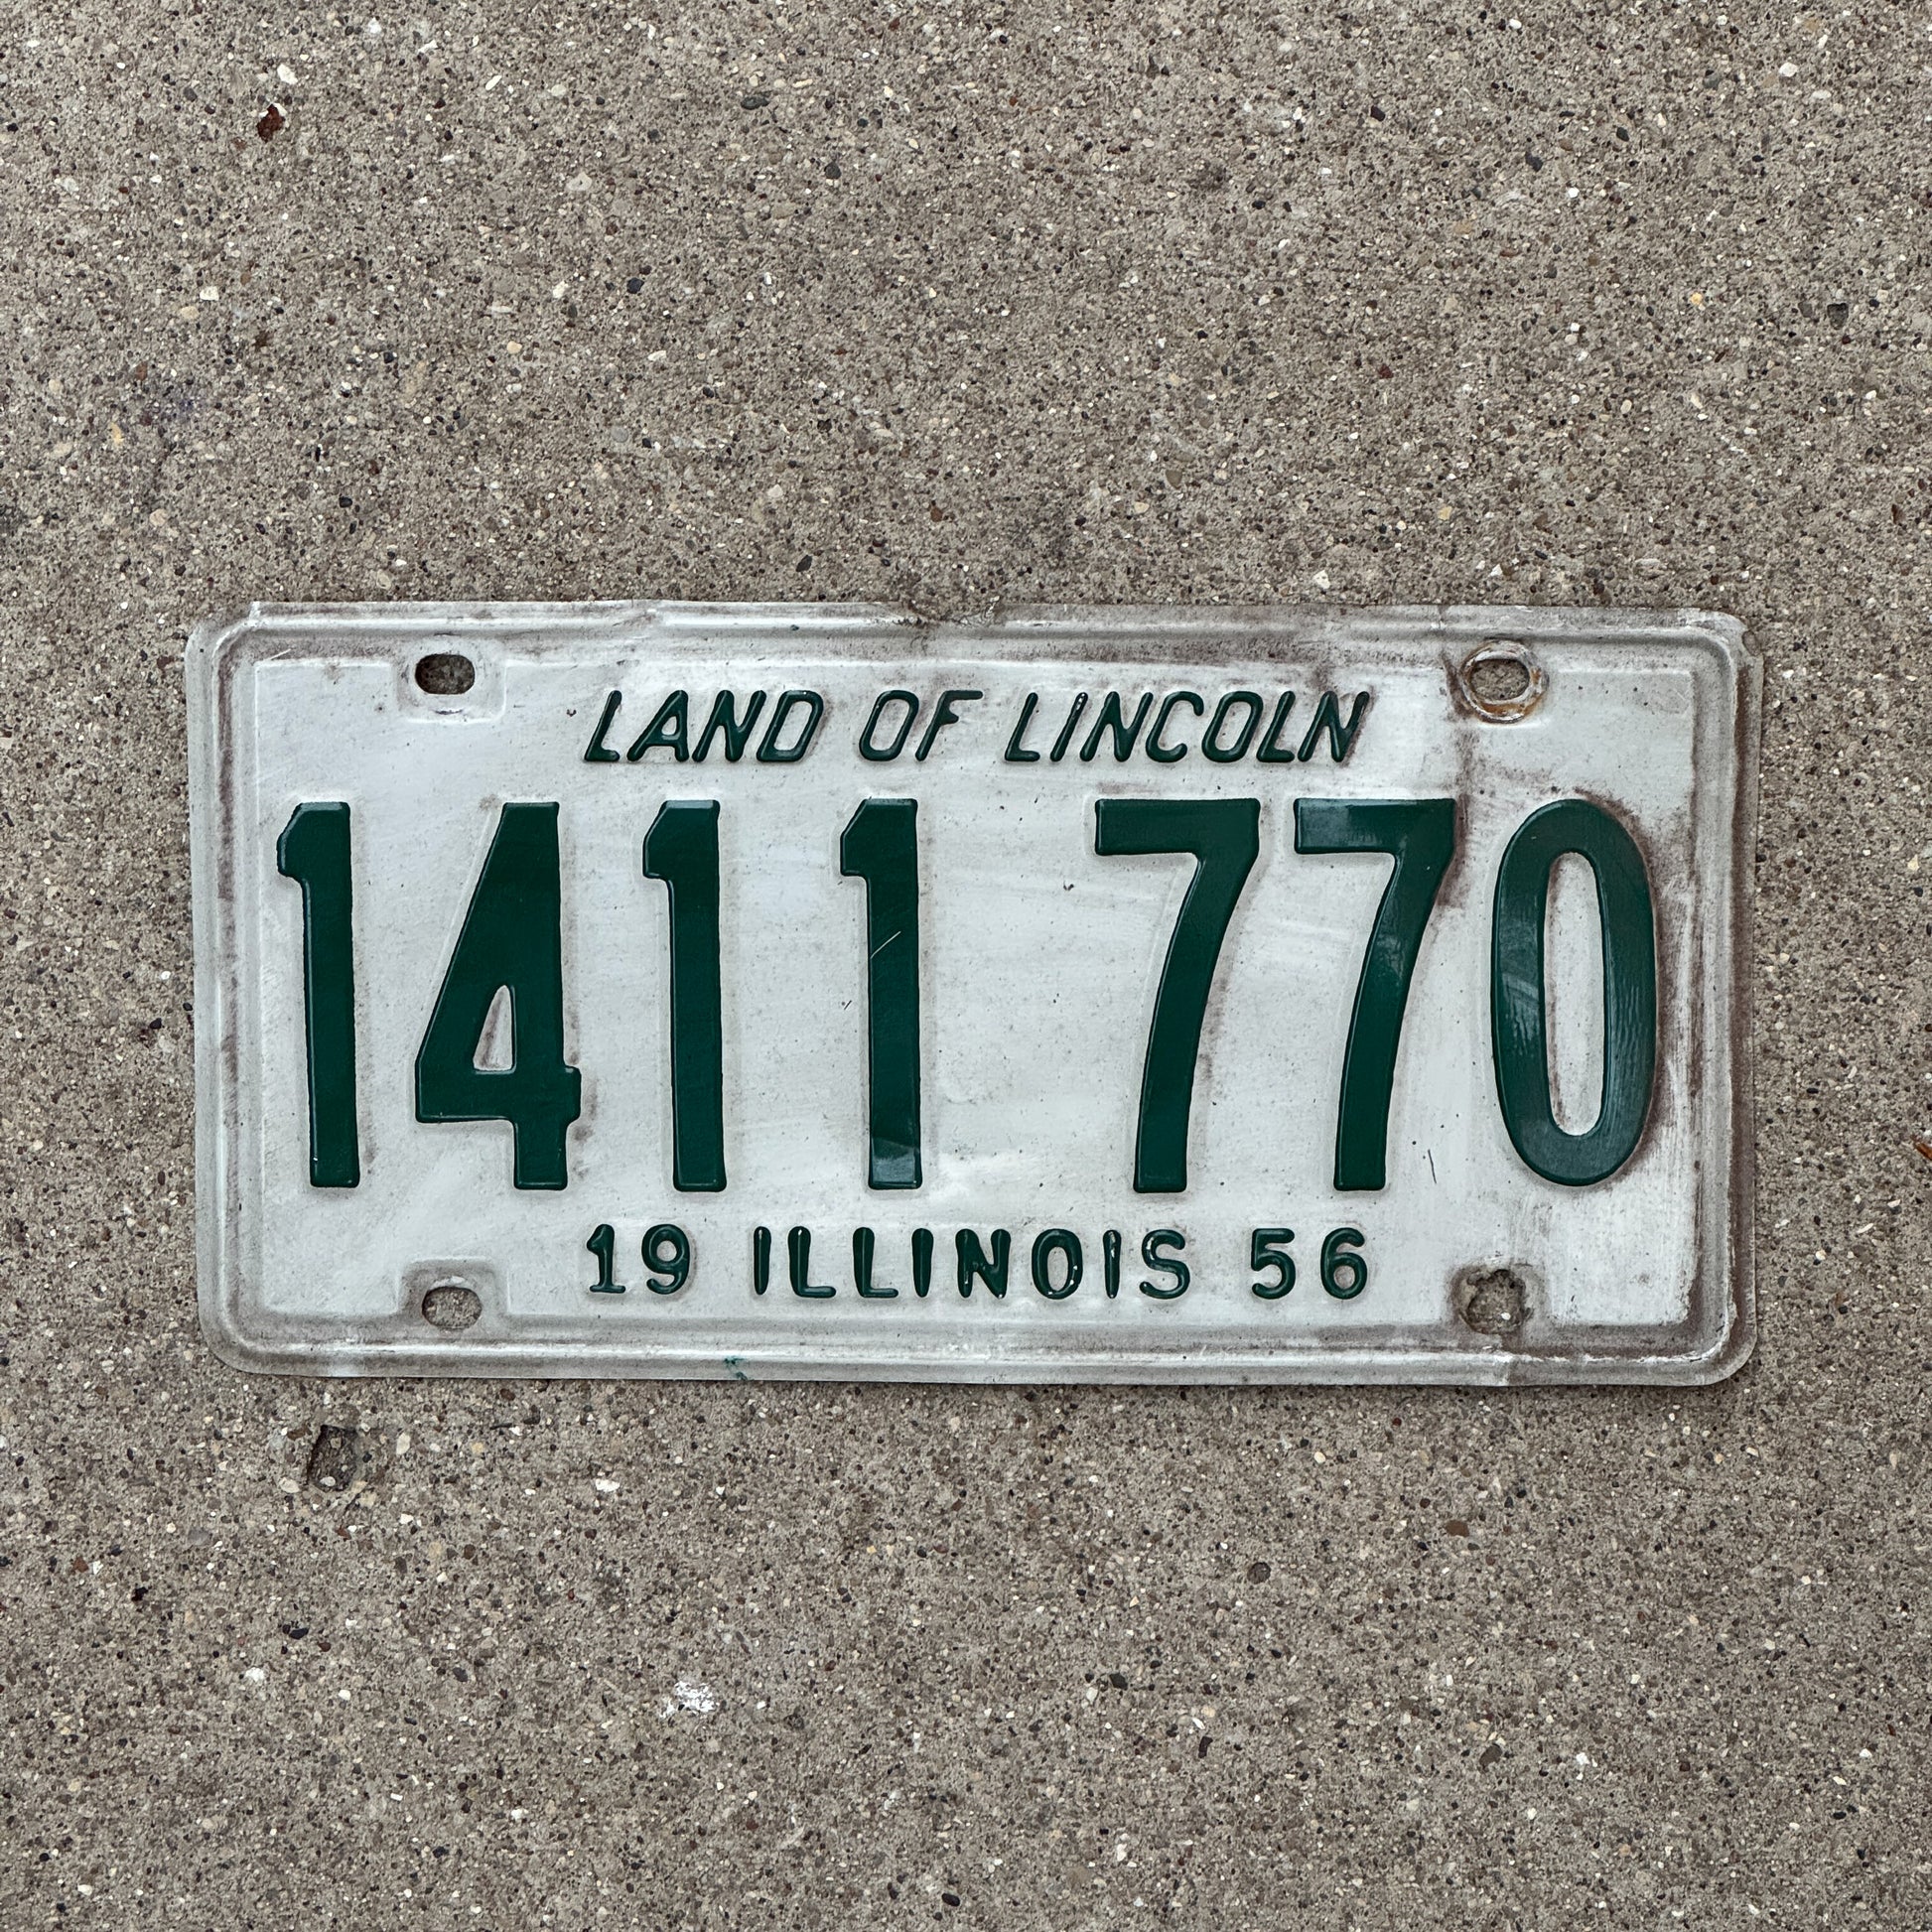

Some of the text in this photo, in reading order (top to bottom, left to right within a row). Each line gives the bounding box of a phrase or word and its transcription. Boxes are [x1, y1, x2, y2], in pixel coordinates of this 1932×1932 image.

[584, 688, 1372, 762] LAND OF LINCOLN
[276, 796, 1657, 1192] 1411 770
[585, 1223, 1369, 1301] 19 ILLINOIS 56
